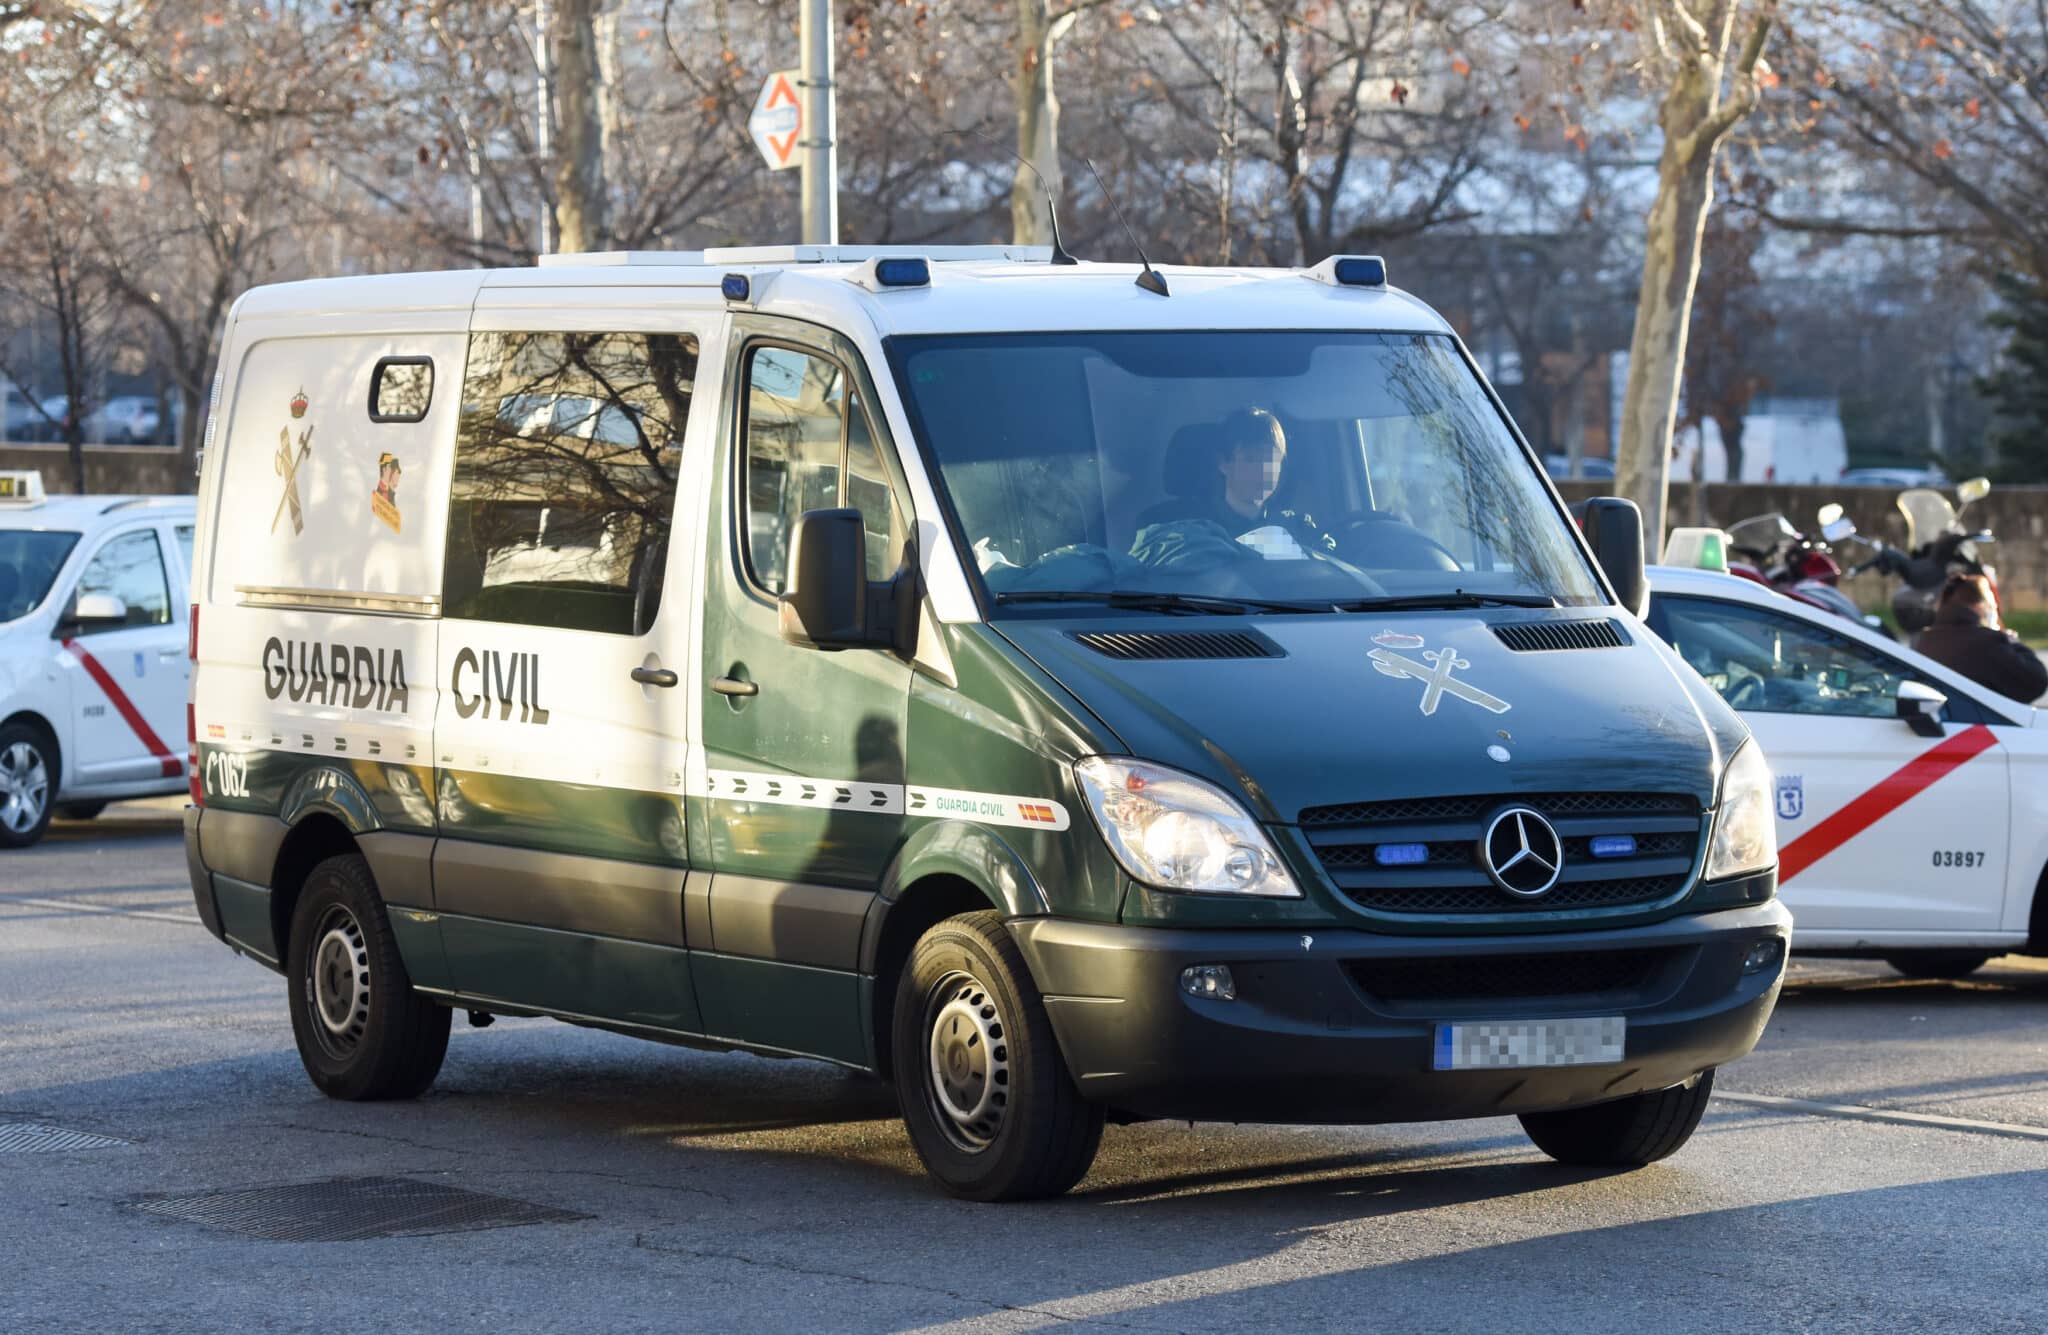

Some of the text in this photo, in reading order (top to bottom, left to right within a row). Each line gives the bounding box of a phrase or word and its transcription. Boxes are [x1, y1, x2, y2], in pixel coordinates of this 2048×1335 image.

[263, 636, 550, 725] GUARDIA CIVIL
[218, 751, 250, 798] 062
[936, 797, 1005, 817] GUARDIA CIVIL
[1932, 850, 1985, 868] 03897
